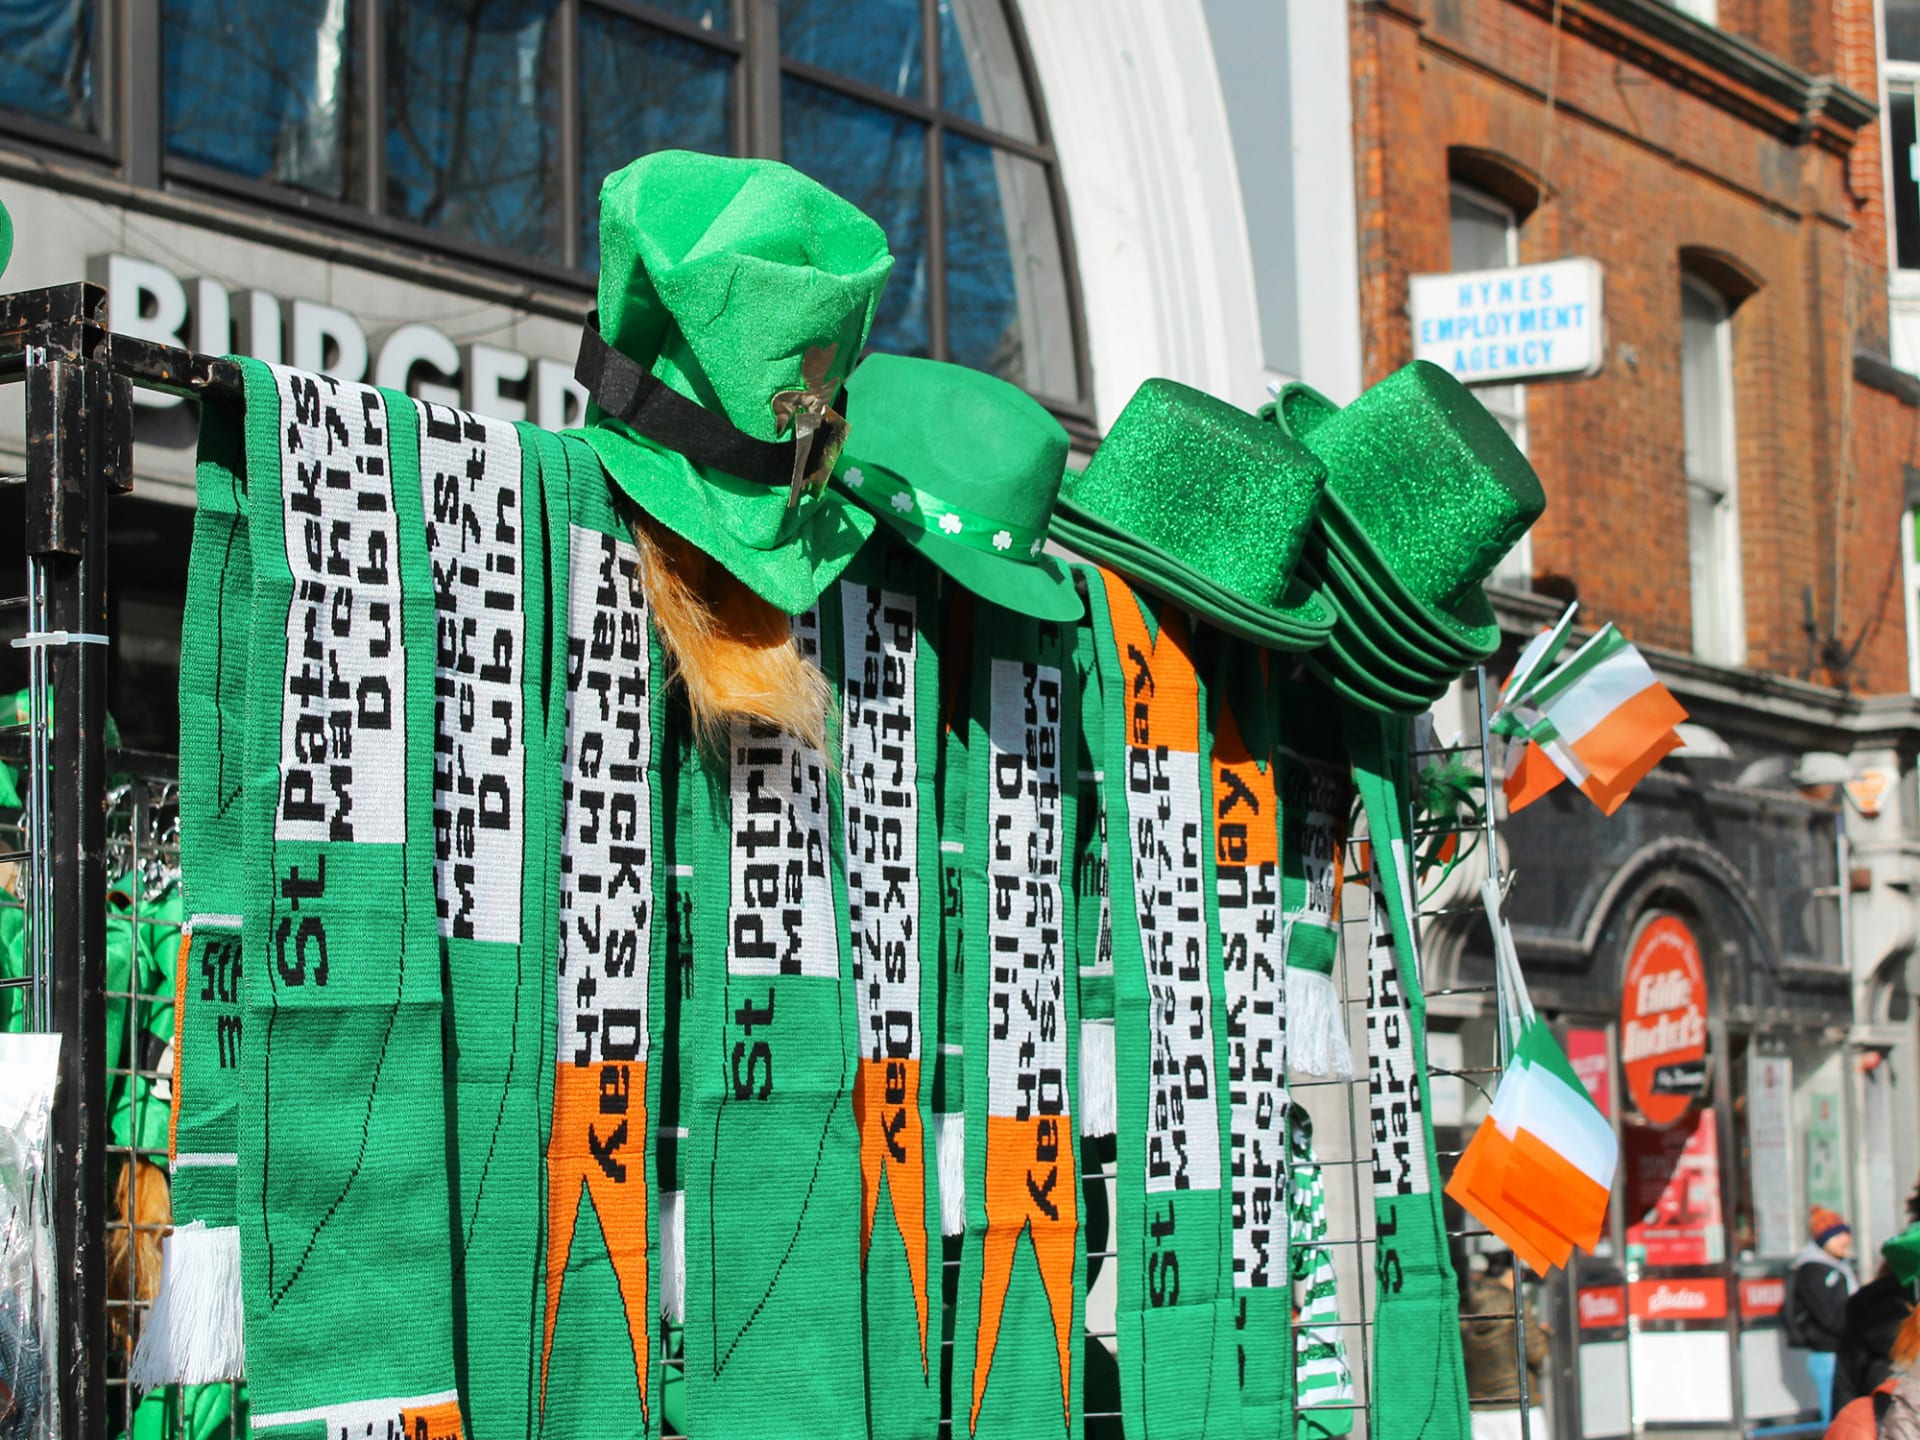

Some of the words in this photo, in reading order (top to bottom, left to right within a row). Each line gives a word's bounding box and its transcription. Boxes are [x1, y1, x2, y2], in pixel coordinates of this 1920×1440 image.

[1421, 303, 1585, 344] EMPLOYMENT
[1454, 339, 1555, 372] AGENCY
[1458, 274, 1554, 308] HYNES
[283, 375, 327, 822] Patrick's
[356, 391, 392, 730] Dublin
[479, 486, 516, 831] Dublin
[327, 520, 354, 842] March
[452, 617, 476, 940] March
[578, 533, 618, 844] March
[603, 557, 648, 979] Patrick's
[862, 587, 882, 865] March
[1022, 661, 1039, 928] March
[1126, 644, 1156, 794] Day
[781, 748, 804, 976] Marc
[881, 606, 914, 984] Patrick's
[993, 752, 1023, 1040] Dublin
[1038, 679, 1061, 1042] Patrick's
[1152, 745, 1173, 907] 17th
[1216, 768, 1260, 909] Day
[276, 854, 329, 987] St
[574, 875, 602, 1068] 17th
[864, 890, 884, 1063] 17th
[1177, 823, 1208, 1100] Dublin
[1251, 861, 1277, 1015] 17th
[588, 1008, 643, 1184] Day
[732, 987, 775, 1102] St
[880, 1011, 913, 1164] Day
[1015, 953, 1040, 1121] 17th
[1026, 1068, 1063, 1221] Day
[1160, 931, 1191, 1190] March
[1380, 968, 1412, 1195] March
[1149, 1200, 1180, 1309] St
[1250, 1038, 1273, 1288] March
